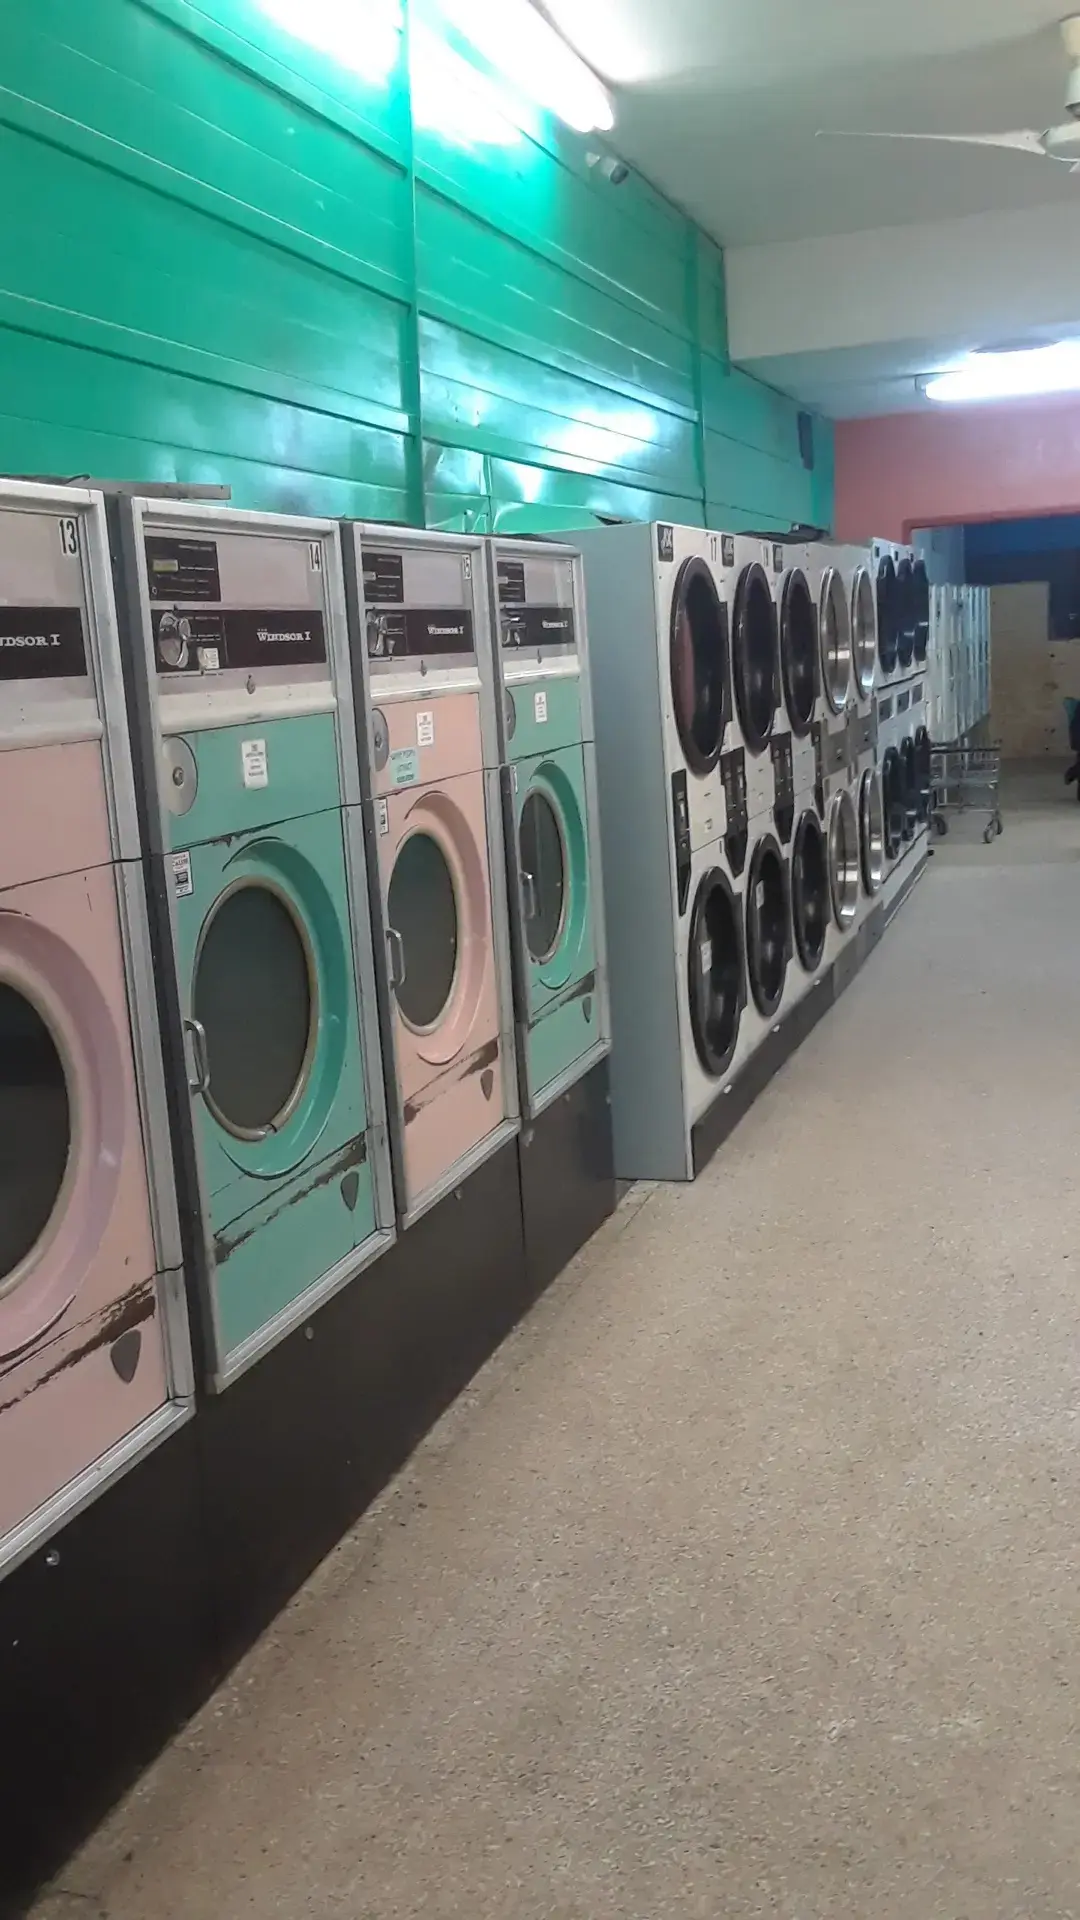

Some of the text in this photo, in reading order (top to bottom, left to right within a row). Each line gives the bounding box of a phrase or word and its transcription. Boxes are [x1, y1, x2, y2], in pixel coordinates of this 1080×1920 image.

[59, 519, 77, 554] 13
[309, 543, 320, 570] 14
[50, 633, 61, 646] I
[256, 631, 304, 642] WINDSOR
